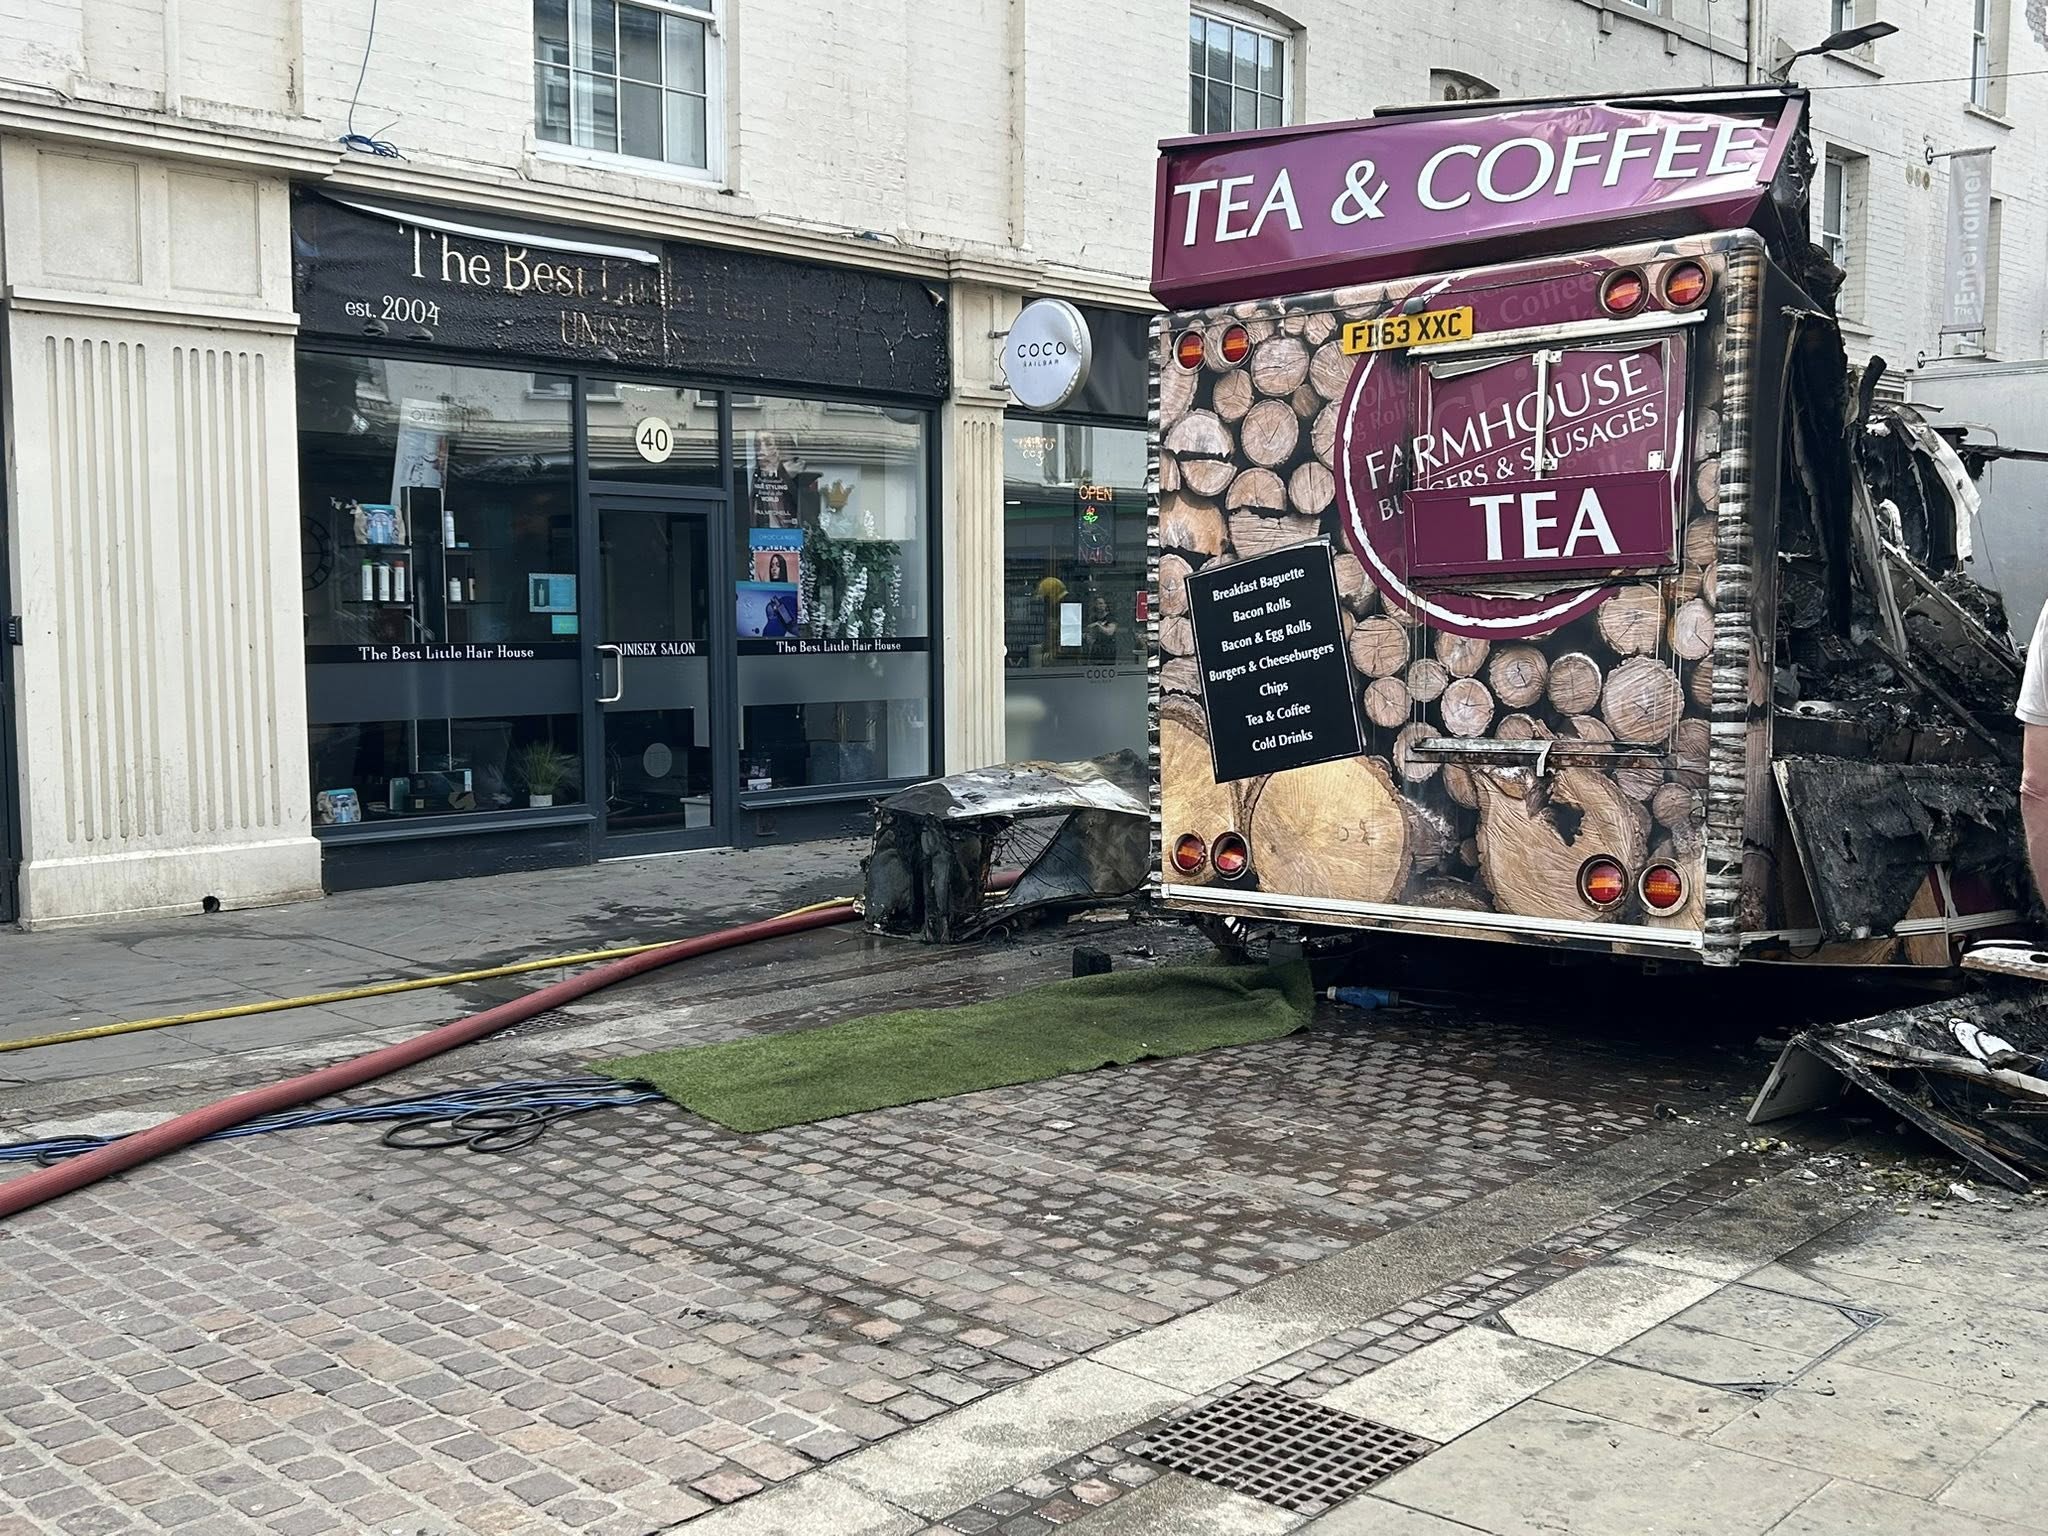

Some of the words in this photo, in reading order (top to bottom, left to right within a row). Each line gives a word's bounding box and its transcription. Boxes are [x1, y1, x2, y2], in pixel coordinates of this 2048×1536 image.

[1172, 167, 1303, 247] TEA
[1329, 159, 1389, 225] &
[1417, 118, 1764, 212] COFFEE
[1953, 168, 1983, 306] Entertainer
[399, 223, 491, 286] The
[503, 244, 589, 298] Best
[345, 299, 377, 320] est.
[381, 295, 440, 327] 2004
[1417, 312, 1462, 341] XXC
[1017, 341, 1067, 358] COCO
[1365, 354, 1649, 491] FARMHOUSE
[640, 427, 668, 453] 40
[1496, 456, 1514, 480] &
[1079, 485, 1113, 502] OPEN
[1469, 487, 1621, 561] TEA
[1080, 544, 1114, 564] NAILS
[1212, 579, 1258, 602] Breakfast
[1259, 567, 1305, 590] Baguette
[1232, 605, 1264, 623] Bacon
[1266, 597, 1292, 615] Rolls
[619, 643, 657, 656] UNISEX
[661, 642, 696, 655] SALON
[776, 640, 797, 653] The
[800, 640, 821, 652] Best
[824, 640, 850, 652] Little
[852, 639, 872, 651] Hair
[875, 639, 901, 650] House
[1221, 635, 1253, 653] Bacon
[1254, 632, 1264, 644] &
[1265, 628, 1284, 643] Egg
[1285, 619, 1312, 637] Rolls
[358, 646, 388, 661] The
[392, 645, 422, 660] Best
[426, 645, 463, 660] Little
[466, 645, 494, 659] Hair
[497, 644, 535, 658] House
[1209, 665, 1247, 683] Burgers
[1248, 661, 1257, 673] &
[1258, 642, 1335, 670] Cheeseburgers
[1086, 668, 1116, 679] COCO
[1259, 680, 1289, 697] Chips
[1245, 713, 1264, 727] Tea
[1265, 710, 1275, 722] &
[1276, 702, 1311, 720] Coffee
[1252, 734, 1277, 752] Cold
[1279, 729, 1314, 747] Drinks
